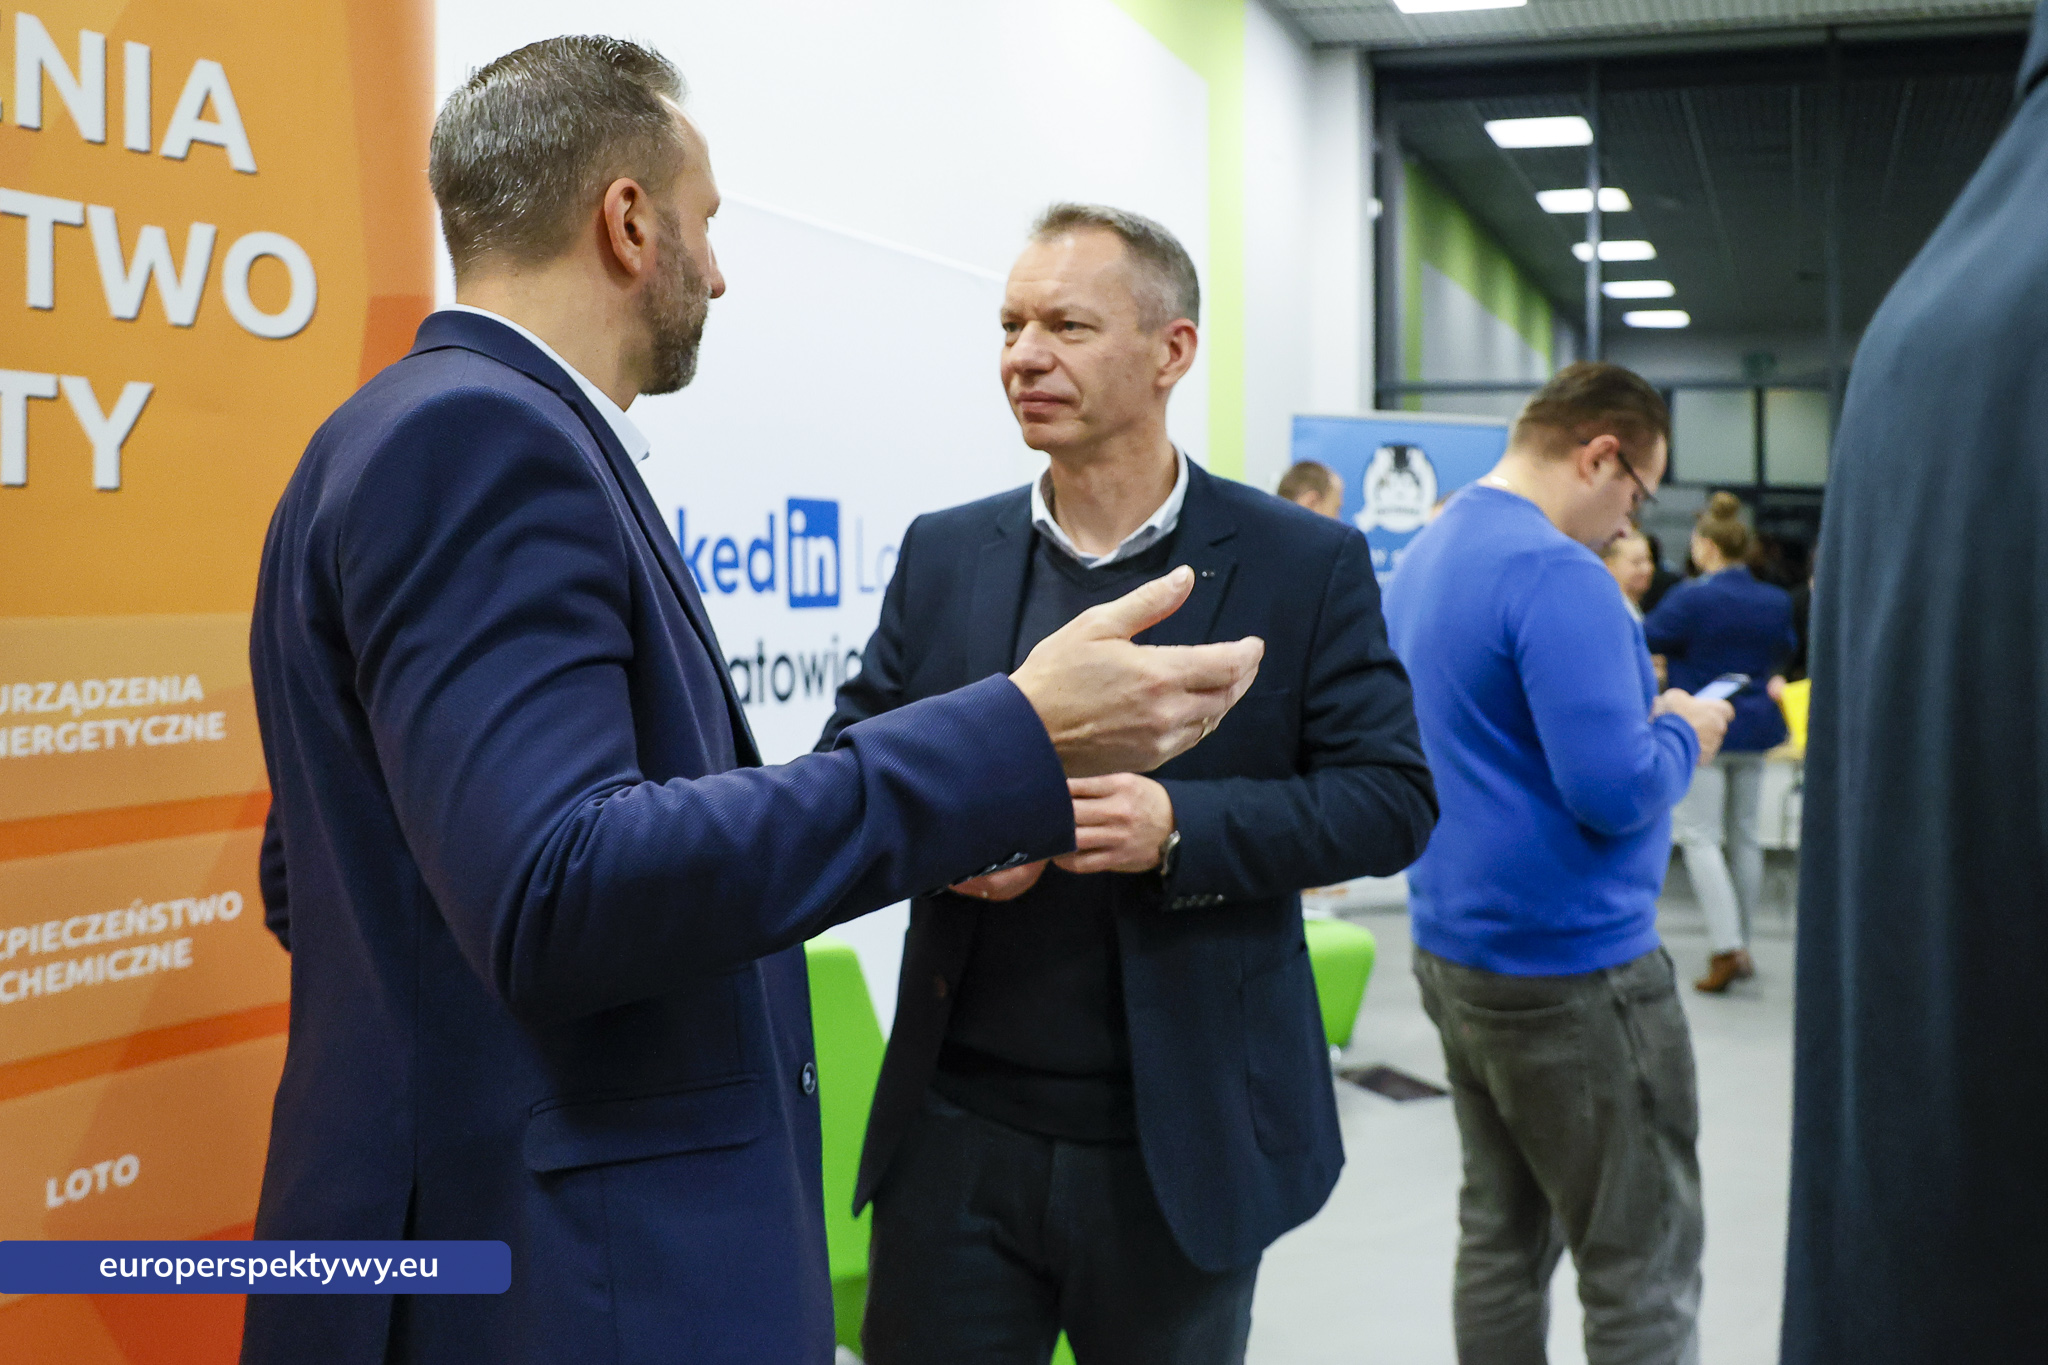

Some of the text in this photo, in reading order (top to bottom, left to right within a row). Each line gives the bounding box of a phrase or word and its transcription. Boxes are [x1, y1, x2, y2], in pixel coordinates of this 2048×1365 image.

[0, 11, 258, 174] NIA
[0, 187, 317, 339] TWO
[0, 369, 154, 491] TY
[0, 937, 194, 1004] CHEMICZNE
[45, 1154, 140, 1208] LOTO
